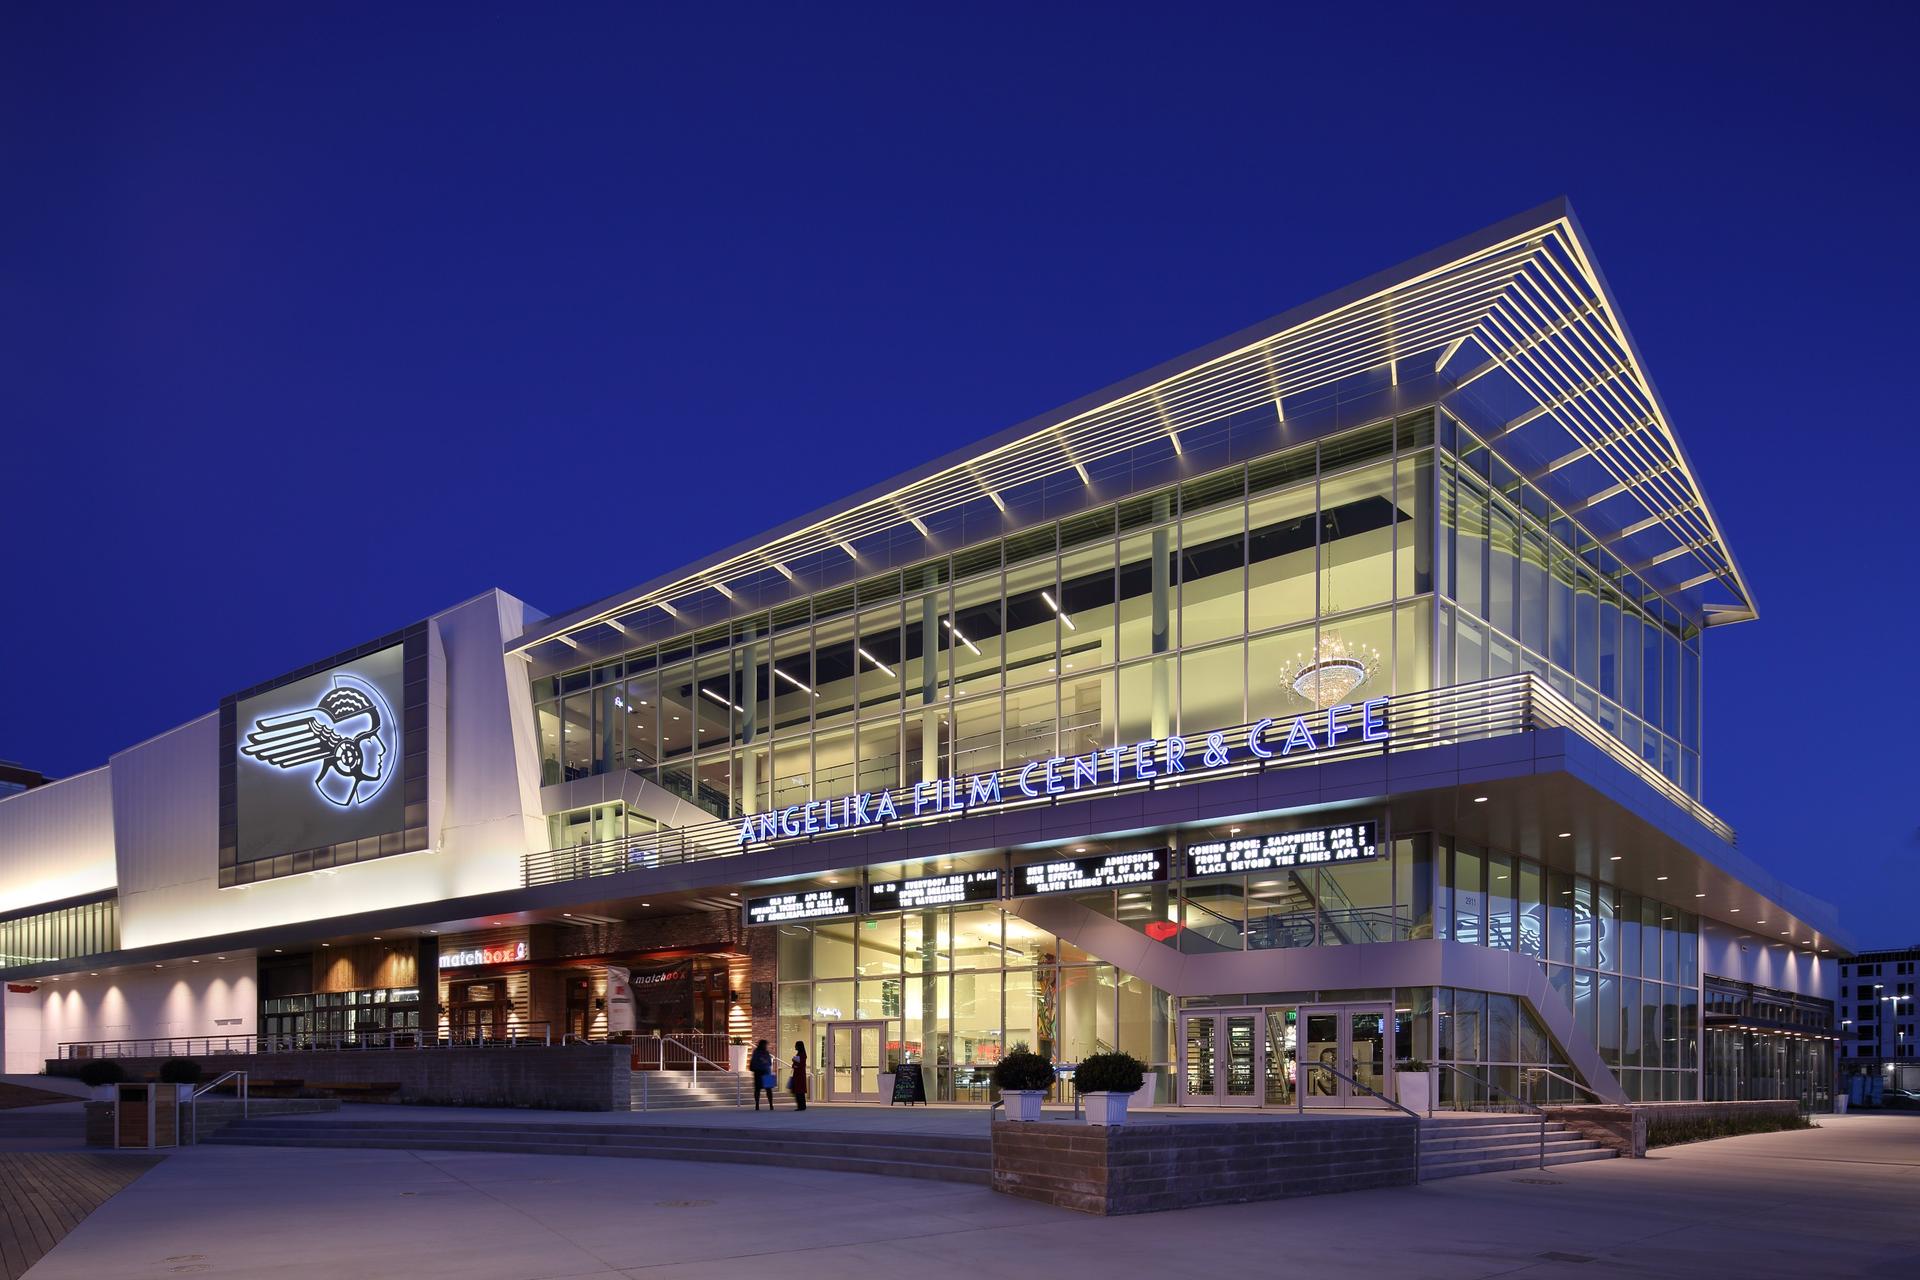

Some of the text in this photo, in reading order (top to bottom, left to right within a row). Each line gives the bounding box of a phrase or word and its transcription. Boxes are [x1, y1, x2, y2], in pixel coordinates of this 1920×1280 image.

[737, 697, 1389, 846] ANGELIKA FILM CENTER & CAFE
[1189, 843, 1225, 856] COMING
[1230, 839, 1260, 851] SOON:
[1330, 828, 1352, 838] APR
[1359, 826, 1365, 835] 5
[1195, 836, 1365, 865] FROM UP ON POPPY HILL APR 5
[1027, 853, 1153, 875] NEW WORLD ADMISSION
[1196, 846, 1375, 874] PLACE BEYOND THE PINES APR 12
[905, 878, 946, 889] EVERYBODY
[950, 876, 964, 884] HAS
[968, 874, 973, 882] A
[977, 872, 997, 880] PLAN
[1027, 862, 1160, 884] SIDE EFFECTS LIFE OF PI 3D
[1037, 871, 1153, 892] SILVER LININGS PLAYBOOK
[899, 884, 964, 899] SPRING BREAKERS
[900, 893, 965, 906] THE GATEKEEPERS
[439, 948, 511, 968] matchbox
[635, 970, 686, 984] matchbox
